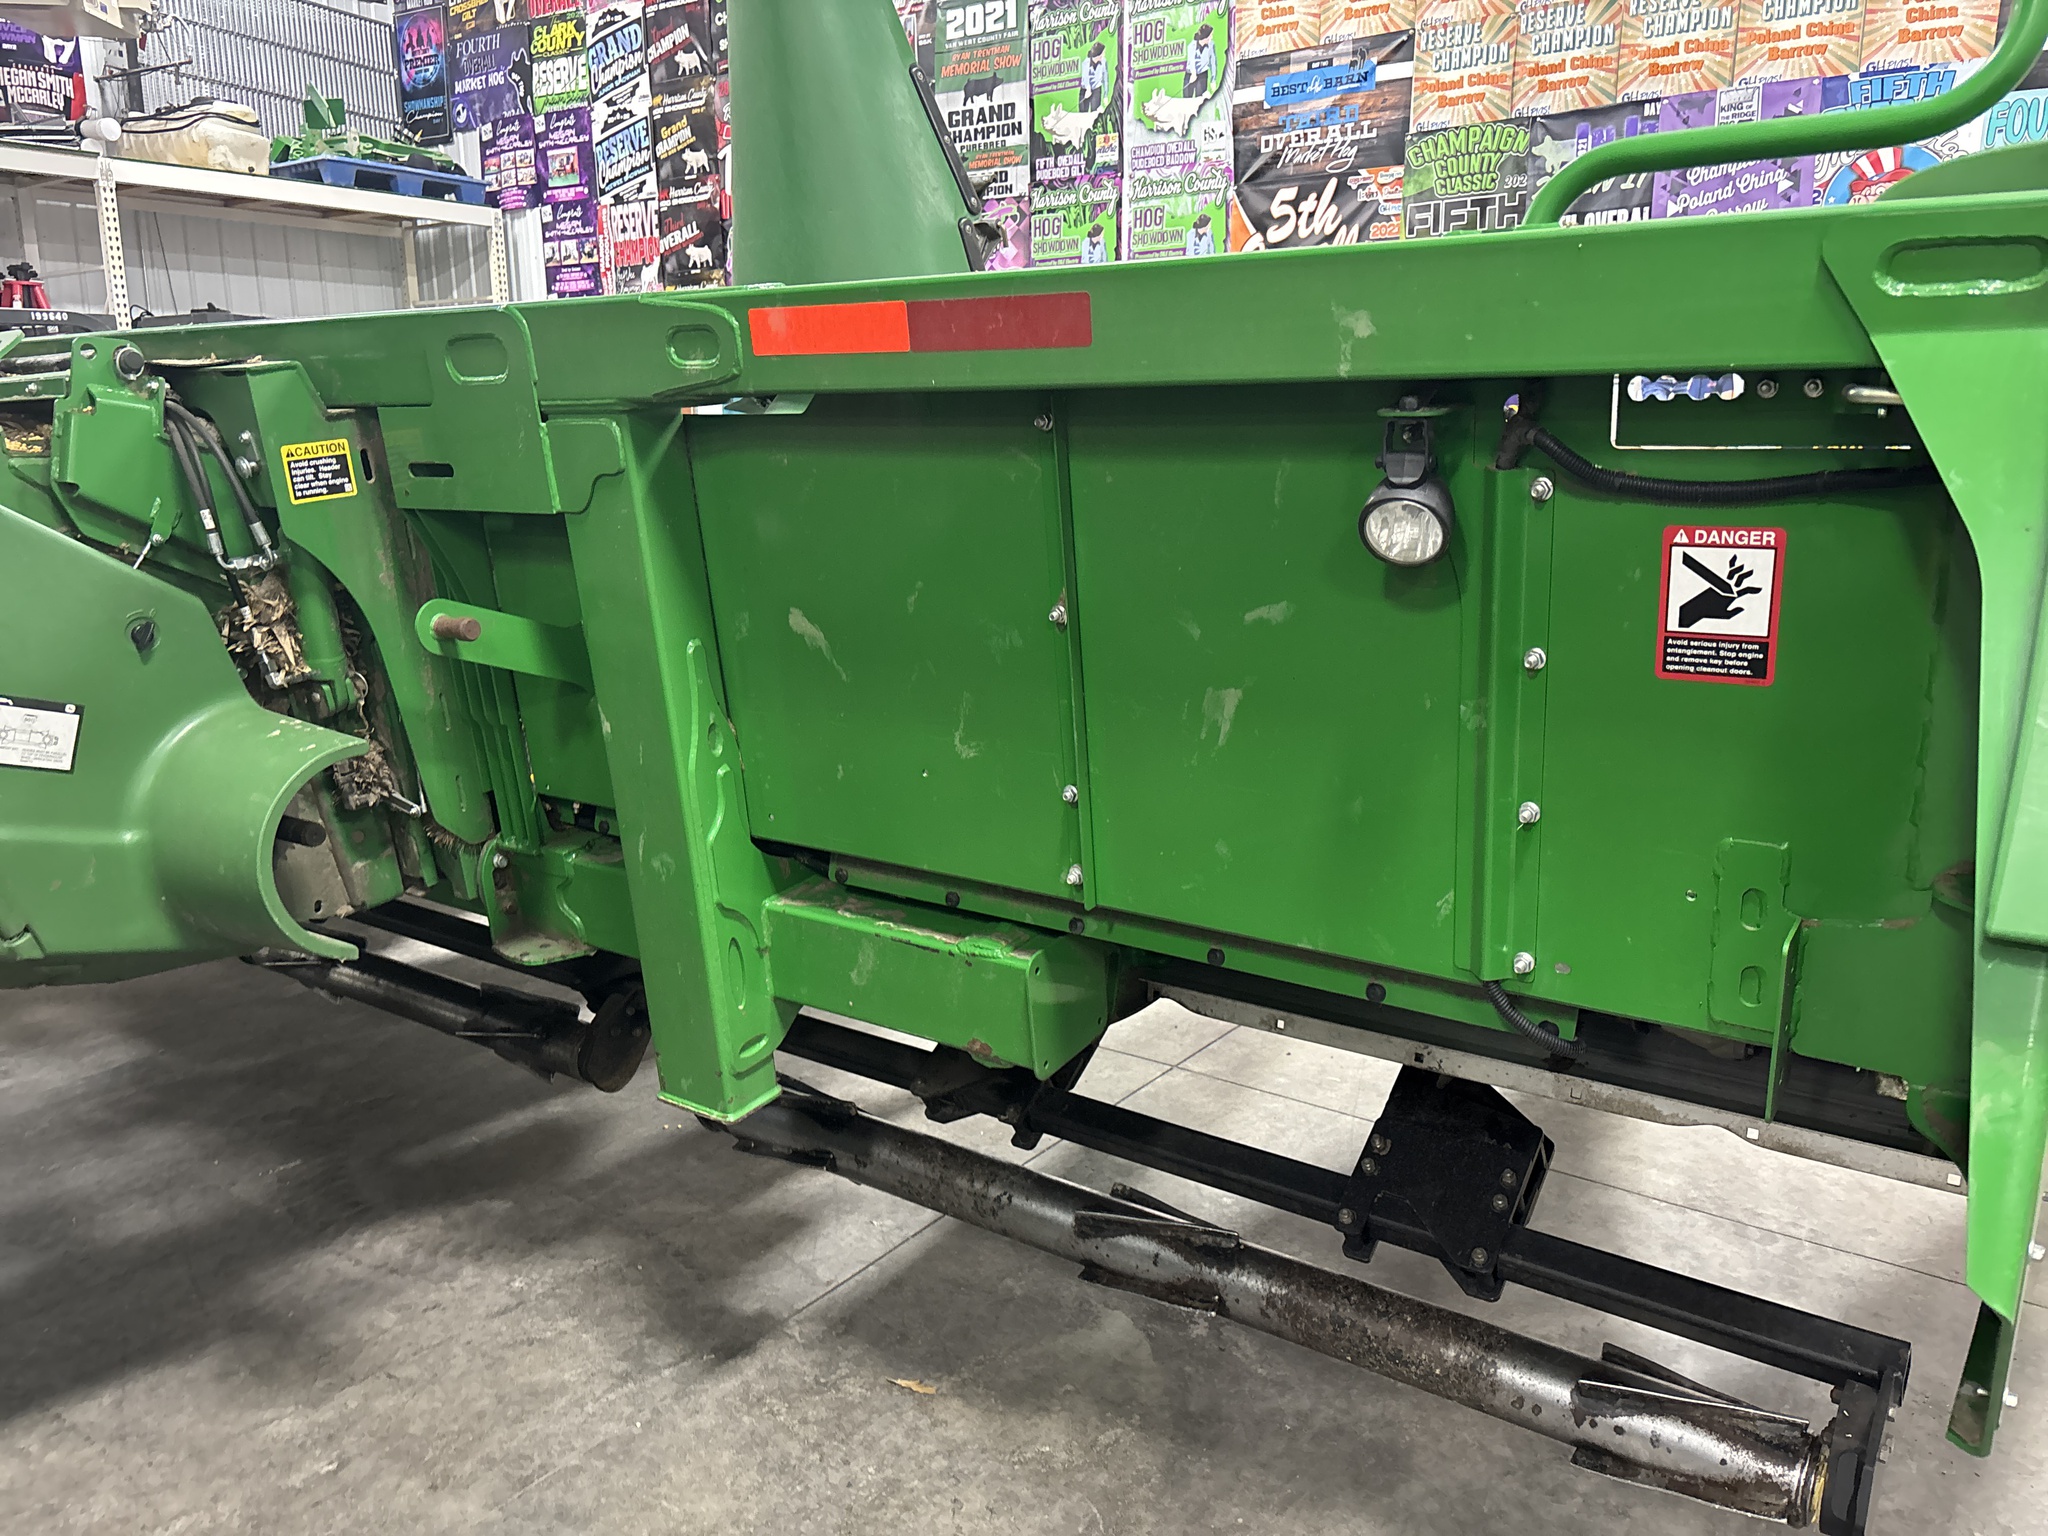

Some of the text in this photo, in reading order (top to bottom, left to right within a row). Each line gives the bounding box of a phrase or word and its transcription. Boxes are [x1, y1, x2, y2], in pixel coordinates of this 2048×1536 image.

[462, 9, 477, 21] GILT
[946, 0, 1017, 40] 2021
[1030, 0, 1119, 34] Harrison County
[1261, 5, 1294, 21] China
[1344, 2, 1391, 21] Barrow
[1520, 3, 1585, 35] RESERVE
[1762, 0, 1859, 21] CHAMPION
[1906, 5, 1959, 24] China
[534, 20, 577, 41] CLARK
[1134, 20, 1163, 45] HOG
[1256, 21, 1299, 37] Barrow
[1643, 5, 1733, 39] CHAMPION
[531, 31, 585, 54] COUNTY
[647, 23, 690, 63] CHAMPION
[977, 34, 1002, 43] COUNTY
[1003, 30, 1019, 38] FAIR
[1420, 21, 1482, 52] RESERVE
[1531, 23, 1615, 55] CHAMPION
[1746, 21, 1855, 46] Poland China
[1899, 25, 1964, 44] Barrow
[456, 33, 500, 58] FOURTH
[543, 49, 570, 57] CLASSIC
[588, 24, 642, 68] GRAND
[952, 45, 1011, 61] RYAN TRENTMAN
[1033, 38, 1060, 62] HOG
[1133, 41, 1184, 63] SHOWDOWN
[1627, 37, 1730, 62] Poland China
[1767, 43, 1828, 61] Barrow
[404, 54, 440, 71] PREMIER
[941, 53, 1022, 78] MEMORIAL SHOW
[1432, 42, 1509, 72] CHAMPION
[1519, 55, 1613, 77] Poland China
[1649, 59, 1704, 77] Barrow
[532, 54, 587, 97] RESERVE
[591, 51, 644, 95] Champion
[1033, 59, 1079, 78] SHOWDOWN
[37, 71, 74, 99] SMITH
[455, 70, 504, 94] MARKET HOG
[1271, 81, 1308, 97] BEST
[1324, 70, 1369, 89] BARN
[1419, 72, 1508, 94] Poland China
[1538, 75, 1589, 93] Barrow
[1850, 70, 1956, 103] FIFTH
[7, 85, 64, 111] MCCARLEY
[1437, 91, 1485, 108] Barrow
[1644, 102, 1661, 116] DAY
[1720, 102, 1744, 112] KING
[948, 102, 1016, 128] GRAND
[1279, 104, 1359, 133] THIRD
[1731, 110, 1757, 119] RIDGE
[661, 115, 688, 139] Grand
[950, 121, 1023, 144] HAMPION
[1261, 120, 1377, 153] OVERALL
[596, 119, 650, 166] RESERVE
[656, 126, 692, 157] CHAMPION
[960, 139, 1007, 153] PUREBRED
[1132, 143, 1165, 158] CHAMPION
[1167, 140, 1196, 154] OVERALL
[1408, 125, 1530, 167] CHAMPAIGN
[969, 155, 1023, 169] MEMORIAL SHOW
[1036, 154, 1086, 169] FIFTH OVERALL
[1166, 152, 1196, 165] BARROW
[1277, 138, 1358, 173] Market Hog
[1435, 152, 1502, 178] COUNTY
[599, 149, 651, 189] Champion
[1071, 165, 1085, 177] GILT
[1132, 168, 1228, 206] Harrison County
[1435, 172, 1498, 195] CLASSIC
[1677, 181, 1735, 213] Poland
[1736, 168, 1788, 194] China
[1031, 179, 1118, 216] Harrison County
[1134, 207, 1163, 229] HOG
[1266, 177, 1342, 243] 5th
[1406, 190, 1527, 238] FIFTH
[611, 200, 659, 243] RESERVE
[664, 213, 684, 233] Third
[1034, 218, 1060, 237] HOG
[660, 221, 700, 254] OVERALL
[1033, 238, 1079, 254] SHOWDOWN
[1133, 229, 1184, 245] SHOWDOWN
[614, 236, 660, 268] CHAMPION
[295, 442, 346, 457] CAUTION
[290, 457, 337, 469] Avoid crushing
[319, 464, 341, 472] Header
[294, 477, 349, 490] clear when engine
[318, 472, 332, 480] Stay
[303, 487, 328, 496] running.
[1694, 529, 1776, 546] DANGER
[1666, 647, 1764, 660] entanglement. Stop engine
[1667, 638, 1688, 646] Avoid
[1690, 640, 1717, 648] serious
[1719, 641, 1740, 650] injury
[1666, 664, 1753, 675] opening cleanout doors.
[1709, 657, 1722, 666] key
[1724, 659, 1748, 667] before
